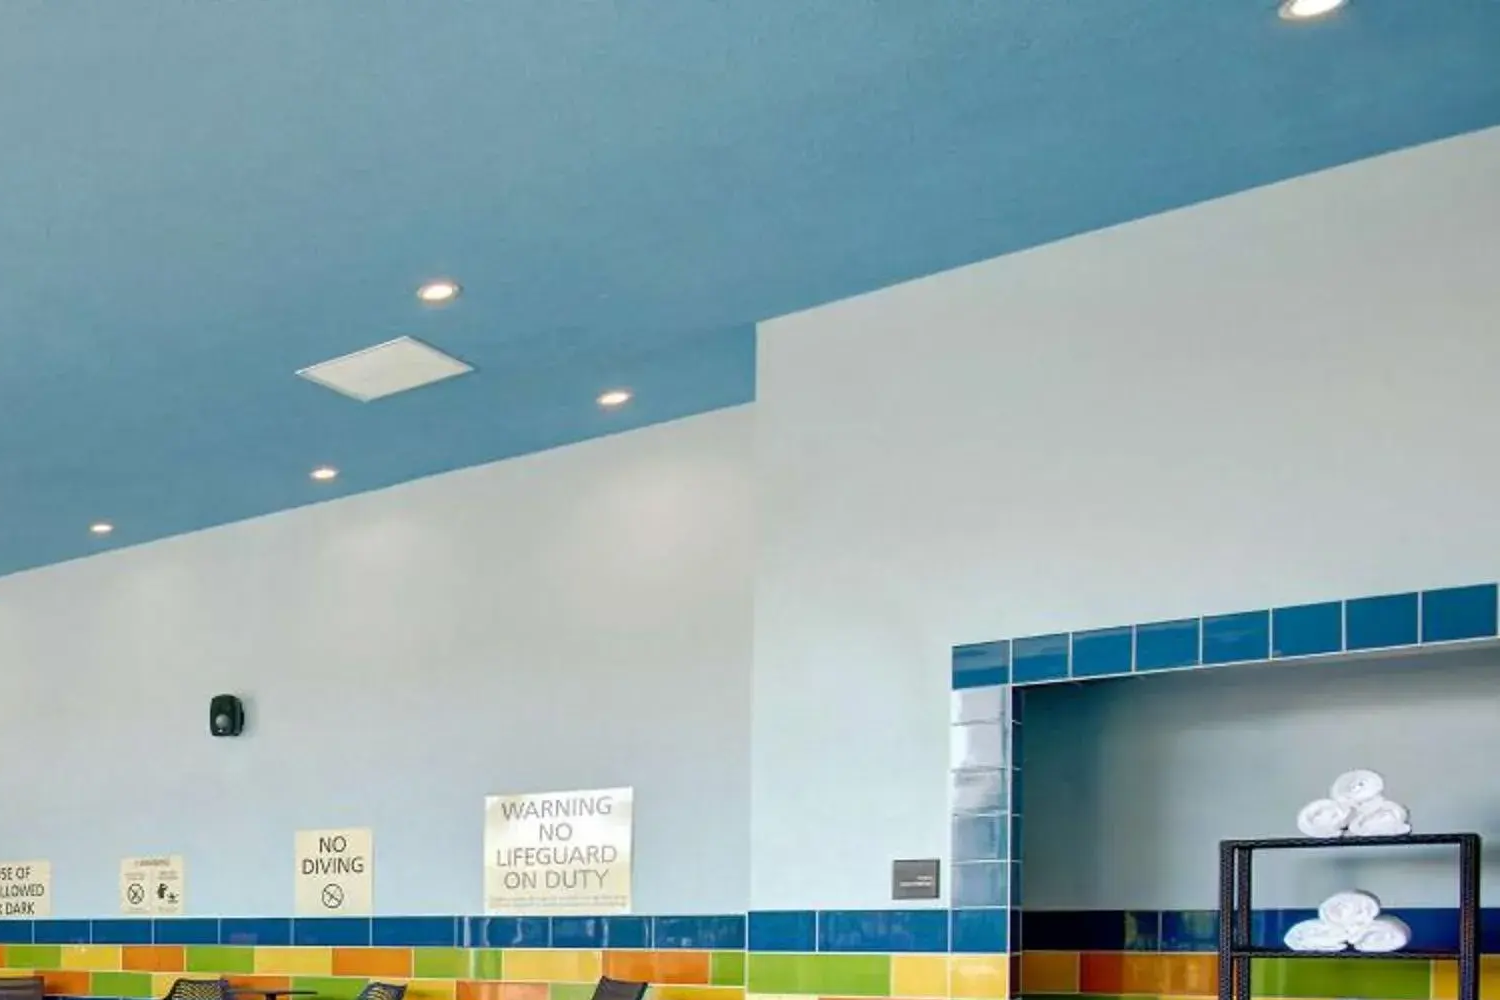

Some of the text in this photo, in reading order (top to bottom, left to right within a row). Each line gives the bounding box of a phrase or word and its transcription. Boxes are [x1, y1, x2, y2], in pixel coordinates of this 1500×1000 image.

[501, 796, 613, 821] WARNING
[538, 822, 573, 842] NO
[318, 835, 347, 853] NO
[301, 856, 364, 875] DIVING
[496, 845, 617, 867] LIFEGUARD
[15, 866, 31, 880] OF
[503, 869, 610, 890] ON DUTY
[5, 901, 35, 915] DARK
